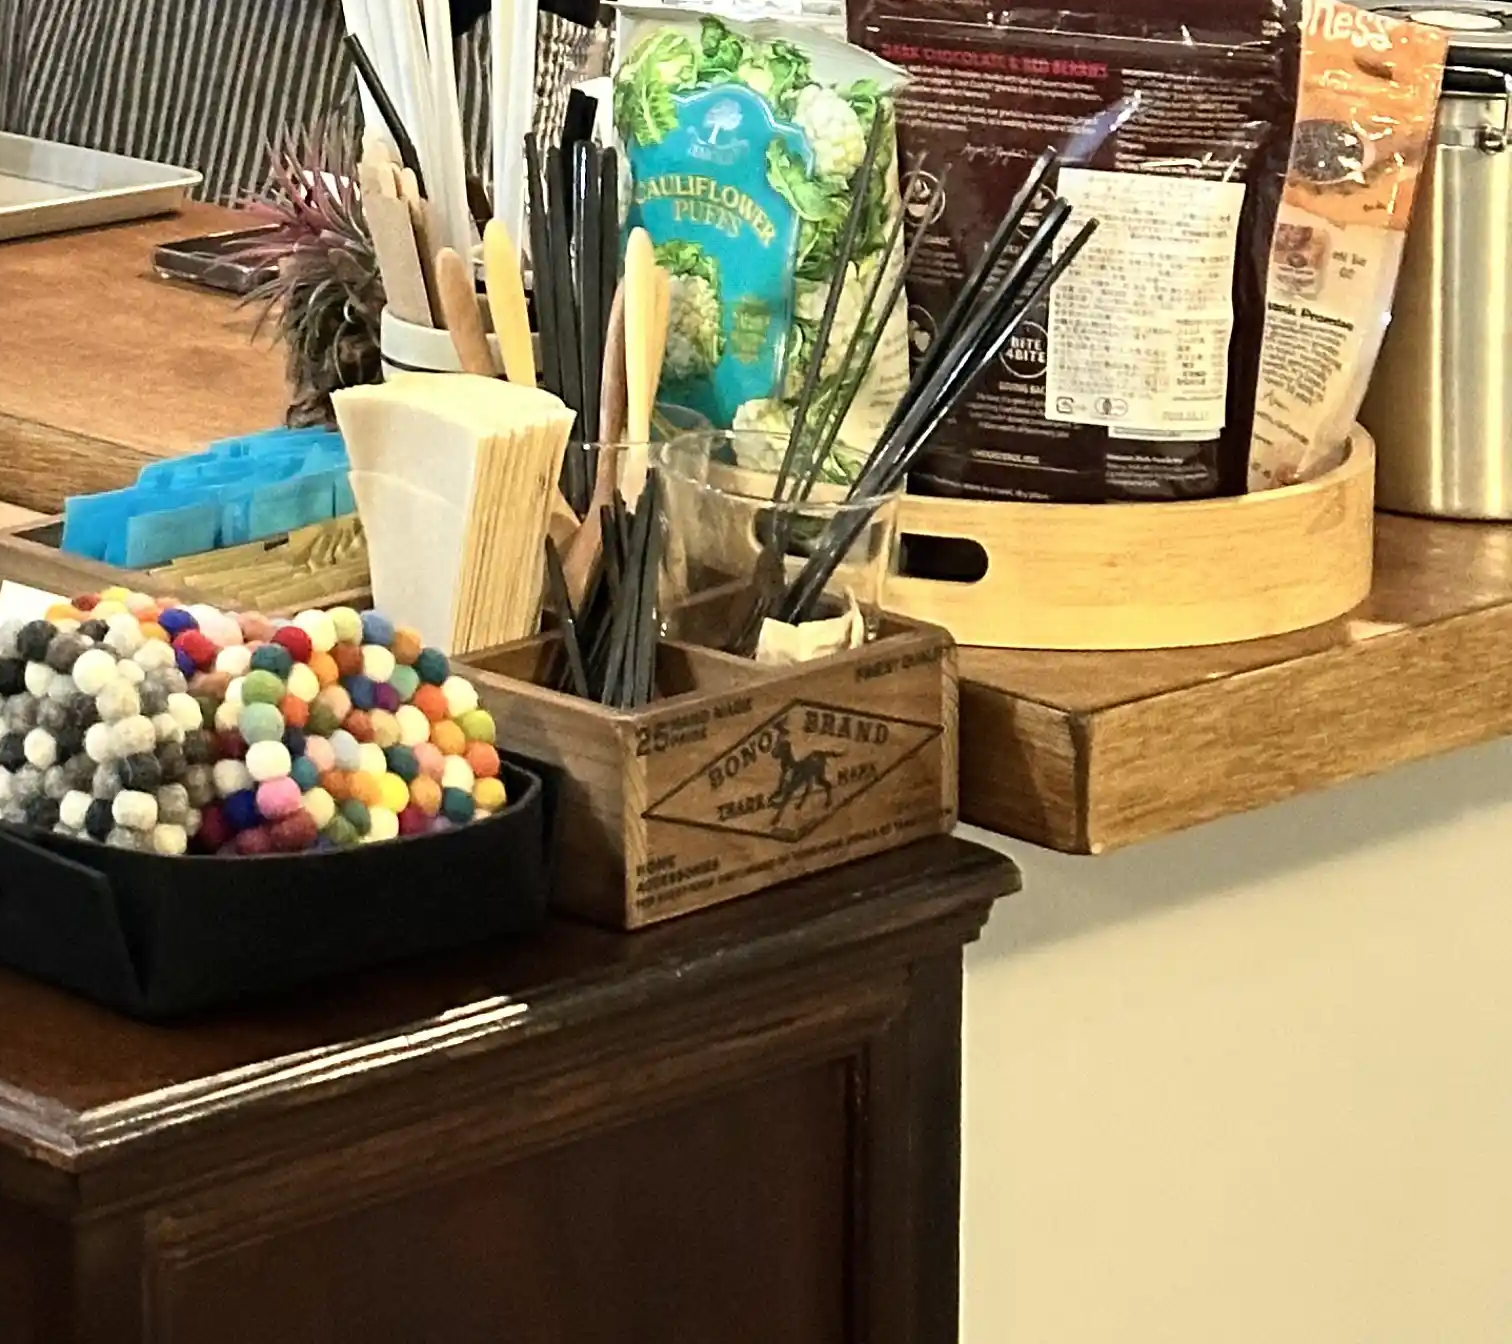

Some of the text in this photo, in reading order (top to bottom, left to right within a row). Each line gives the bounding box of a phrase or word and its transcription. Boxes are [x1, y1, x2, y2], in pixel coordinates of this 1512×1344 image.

[635, 174, 776, 249] CAULIFLOWER
[673, 199, 742, 239] PUFFS
[1005, 348, 1046, 364] 4BITE
[1010, 336, 1042, 351] BITE
[635, 723, 668, 758] 25
[802, 711, 890, 746] BRAND
